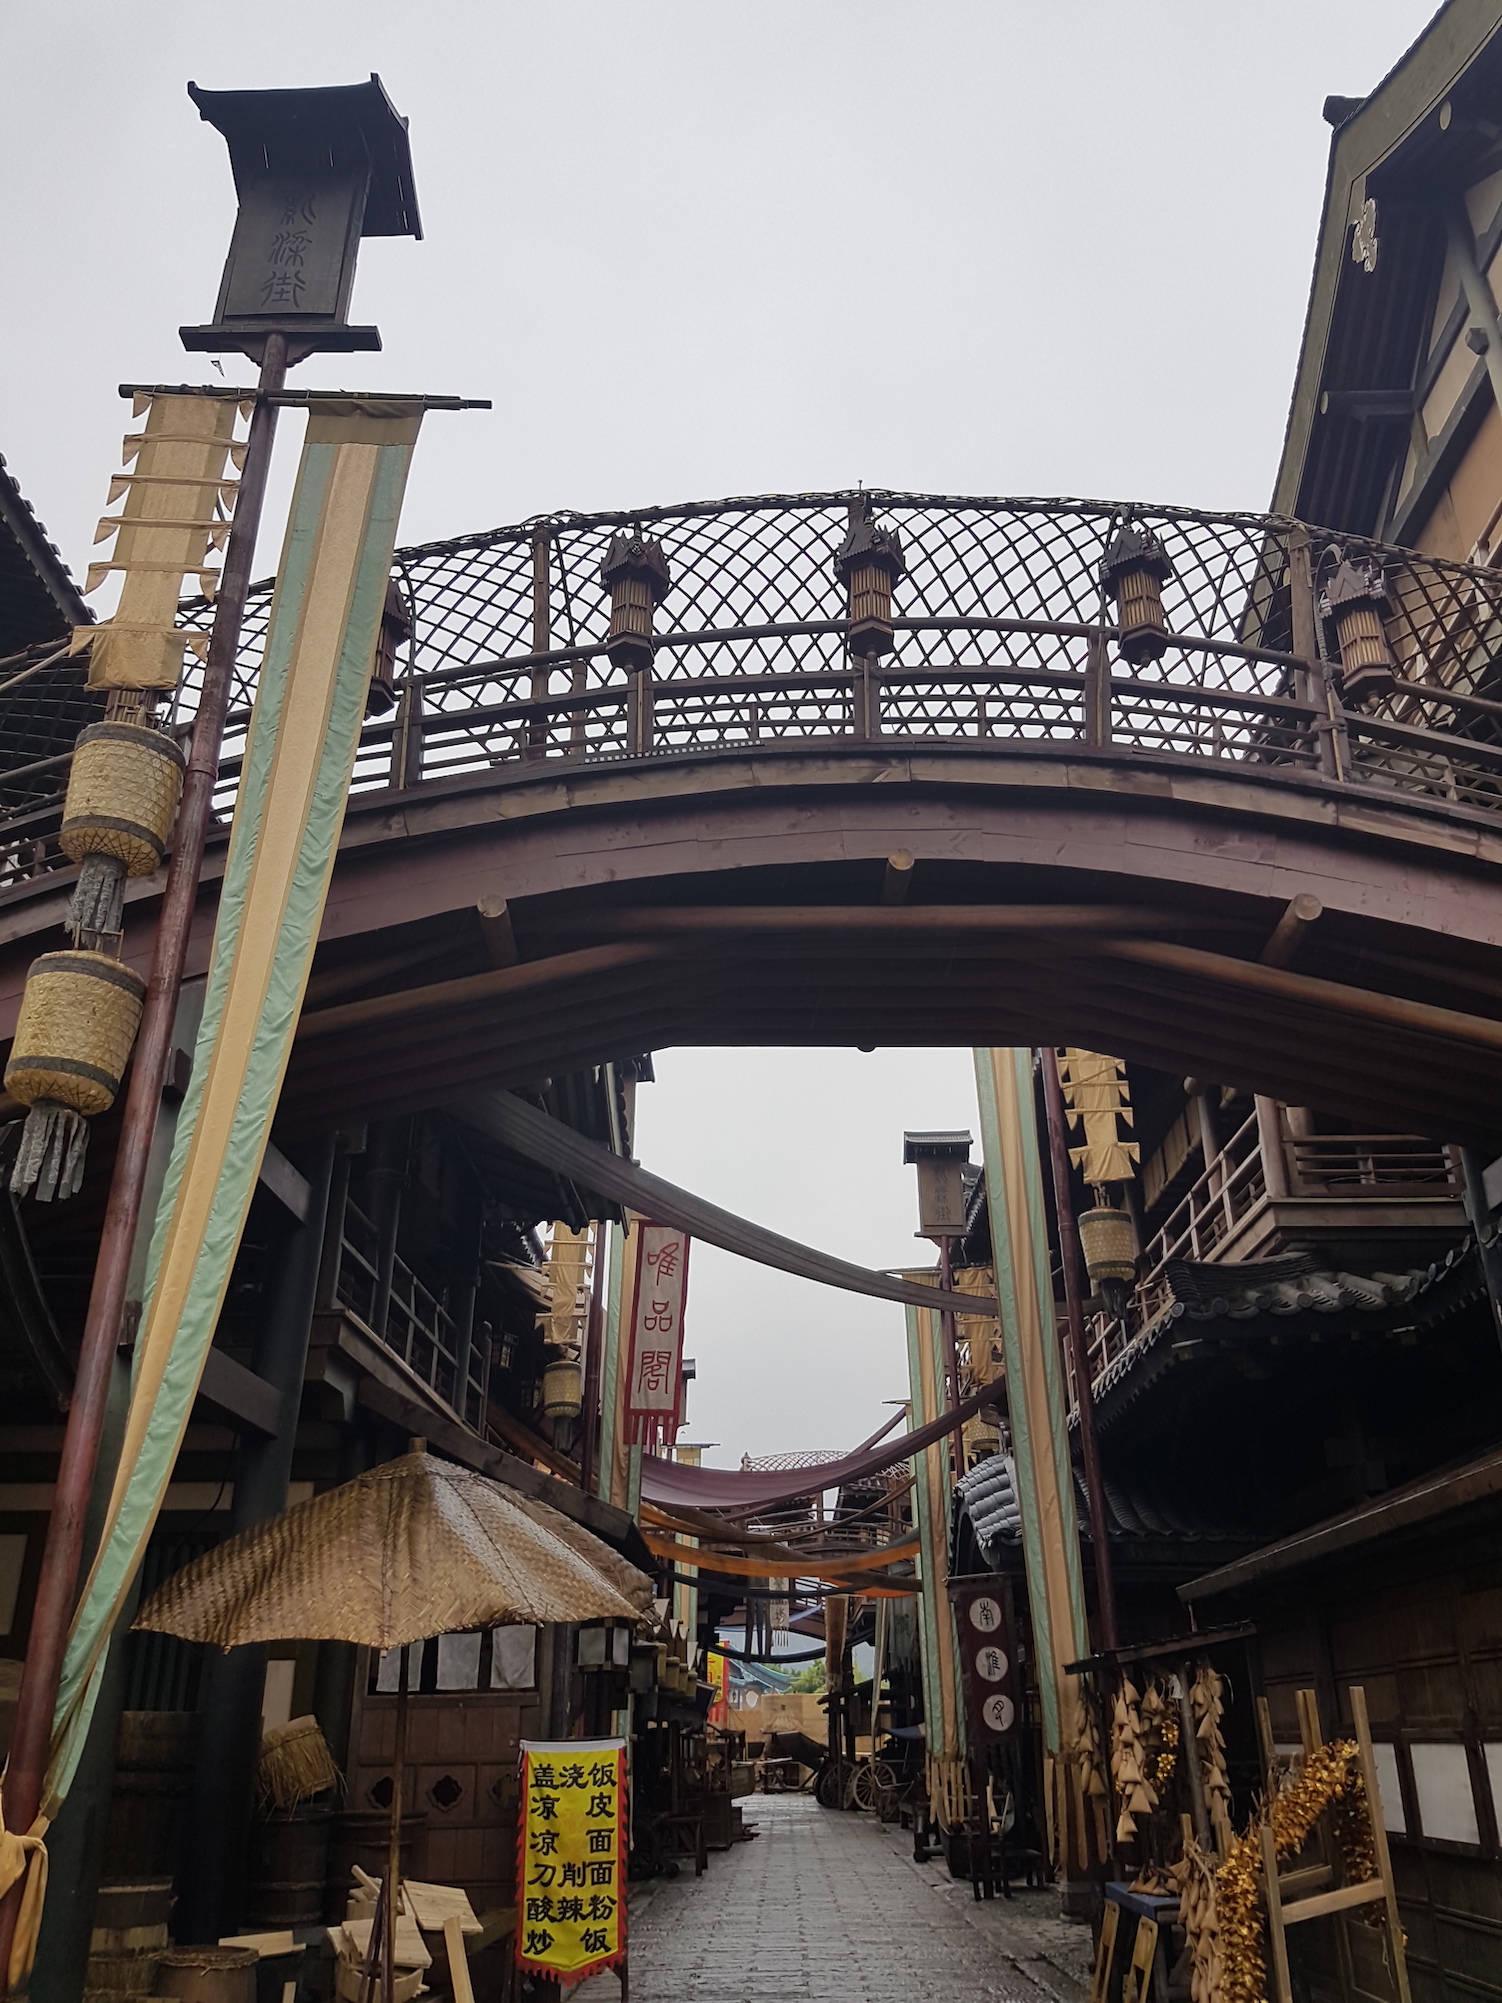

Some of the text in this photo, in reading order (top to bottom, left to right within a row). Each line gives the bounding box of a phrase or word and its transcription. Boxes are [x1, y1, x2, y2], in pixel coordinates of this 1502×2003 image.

[530, 1762, 617, 1790] 盖浇饭
[530, 1792, 616, 1820] 凉皮
[530, 1827, 616, 1856] 凉面
[527, 1860, 616, 1888] 刀削面
[525, 1894, 617, 1923] 酸辣粉
[523, 1927, 611, 1955] 炒饭
